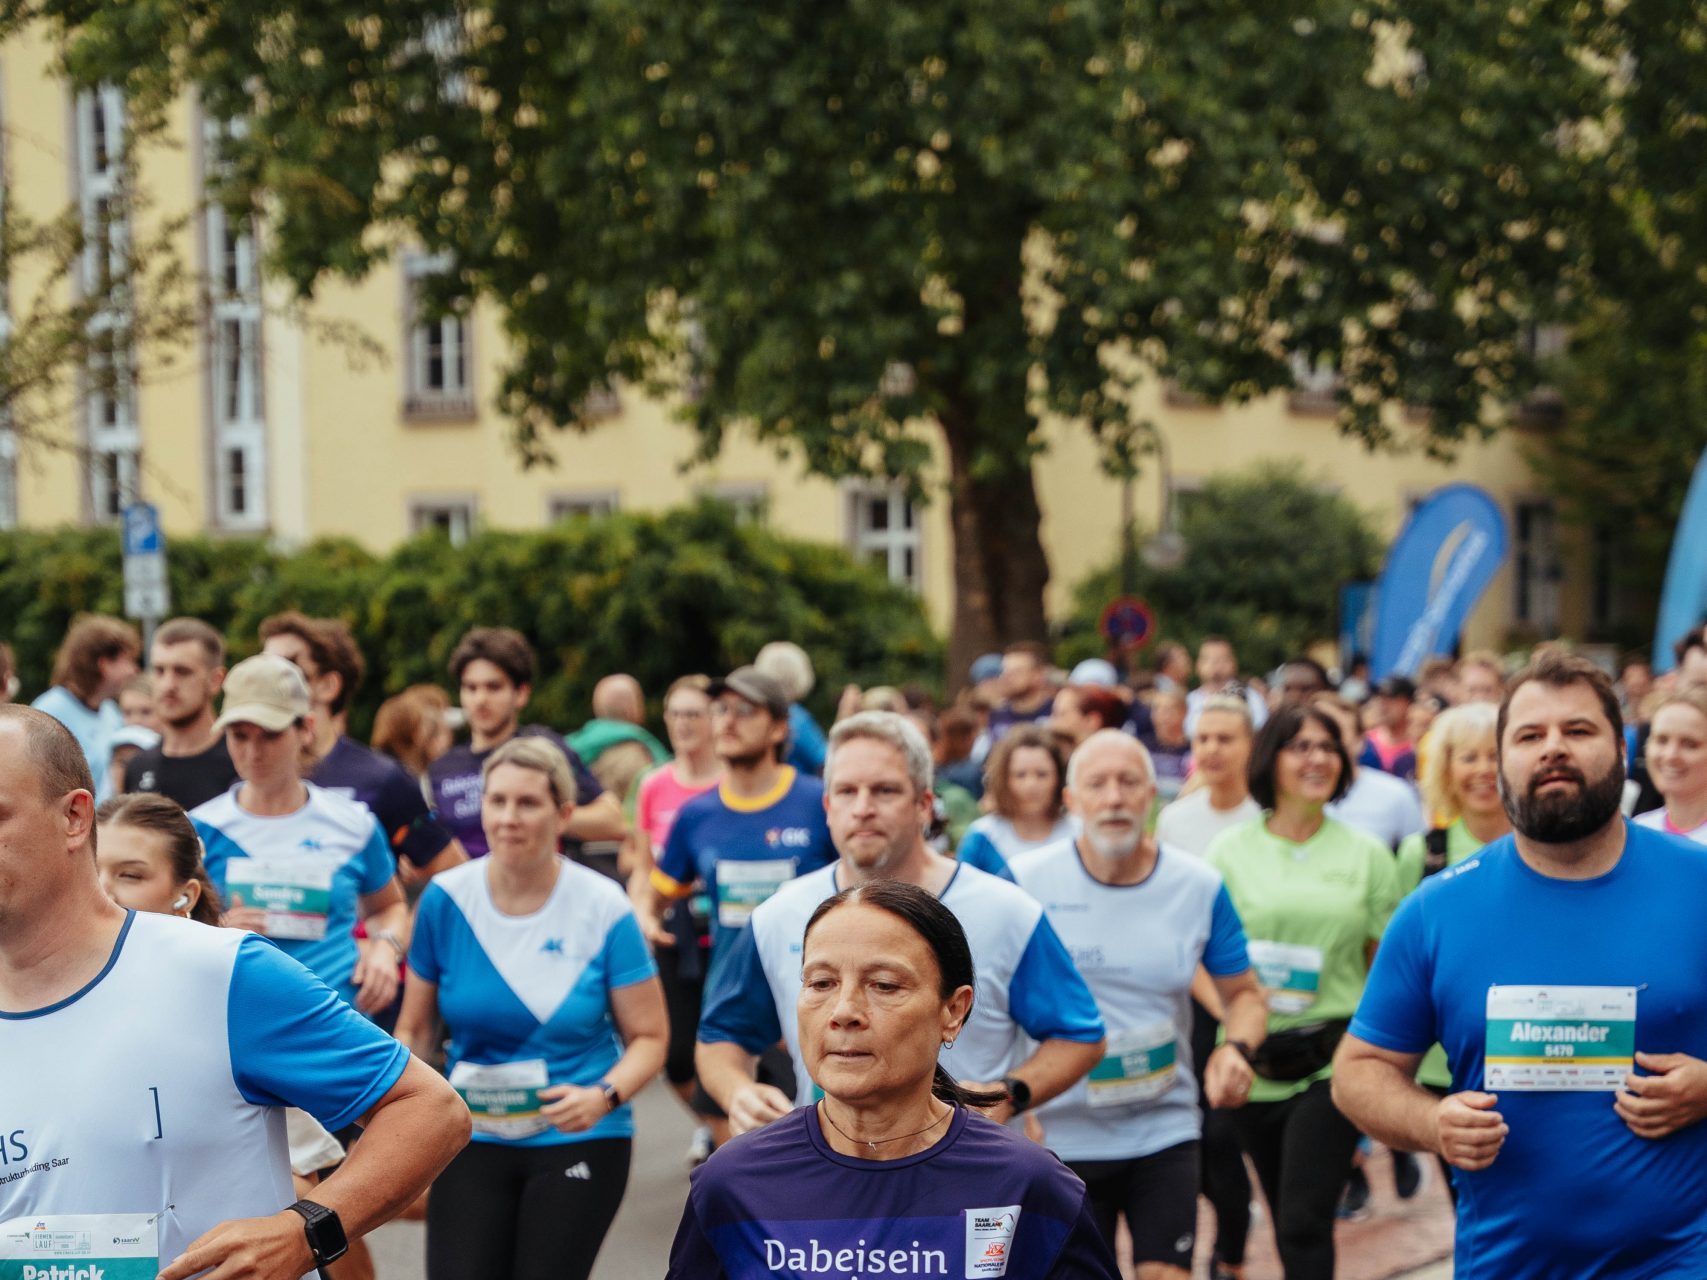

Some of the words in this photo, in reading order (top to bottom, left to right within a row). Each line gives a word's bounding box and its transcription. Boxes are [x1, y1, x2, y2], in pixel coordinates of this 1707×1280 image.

[1510, 1021, 1610, 1042] Alexander
[51, 1157, 70, 1167] Saar
[763, 1239, 948, 1275] Dabeisein
